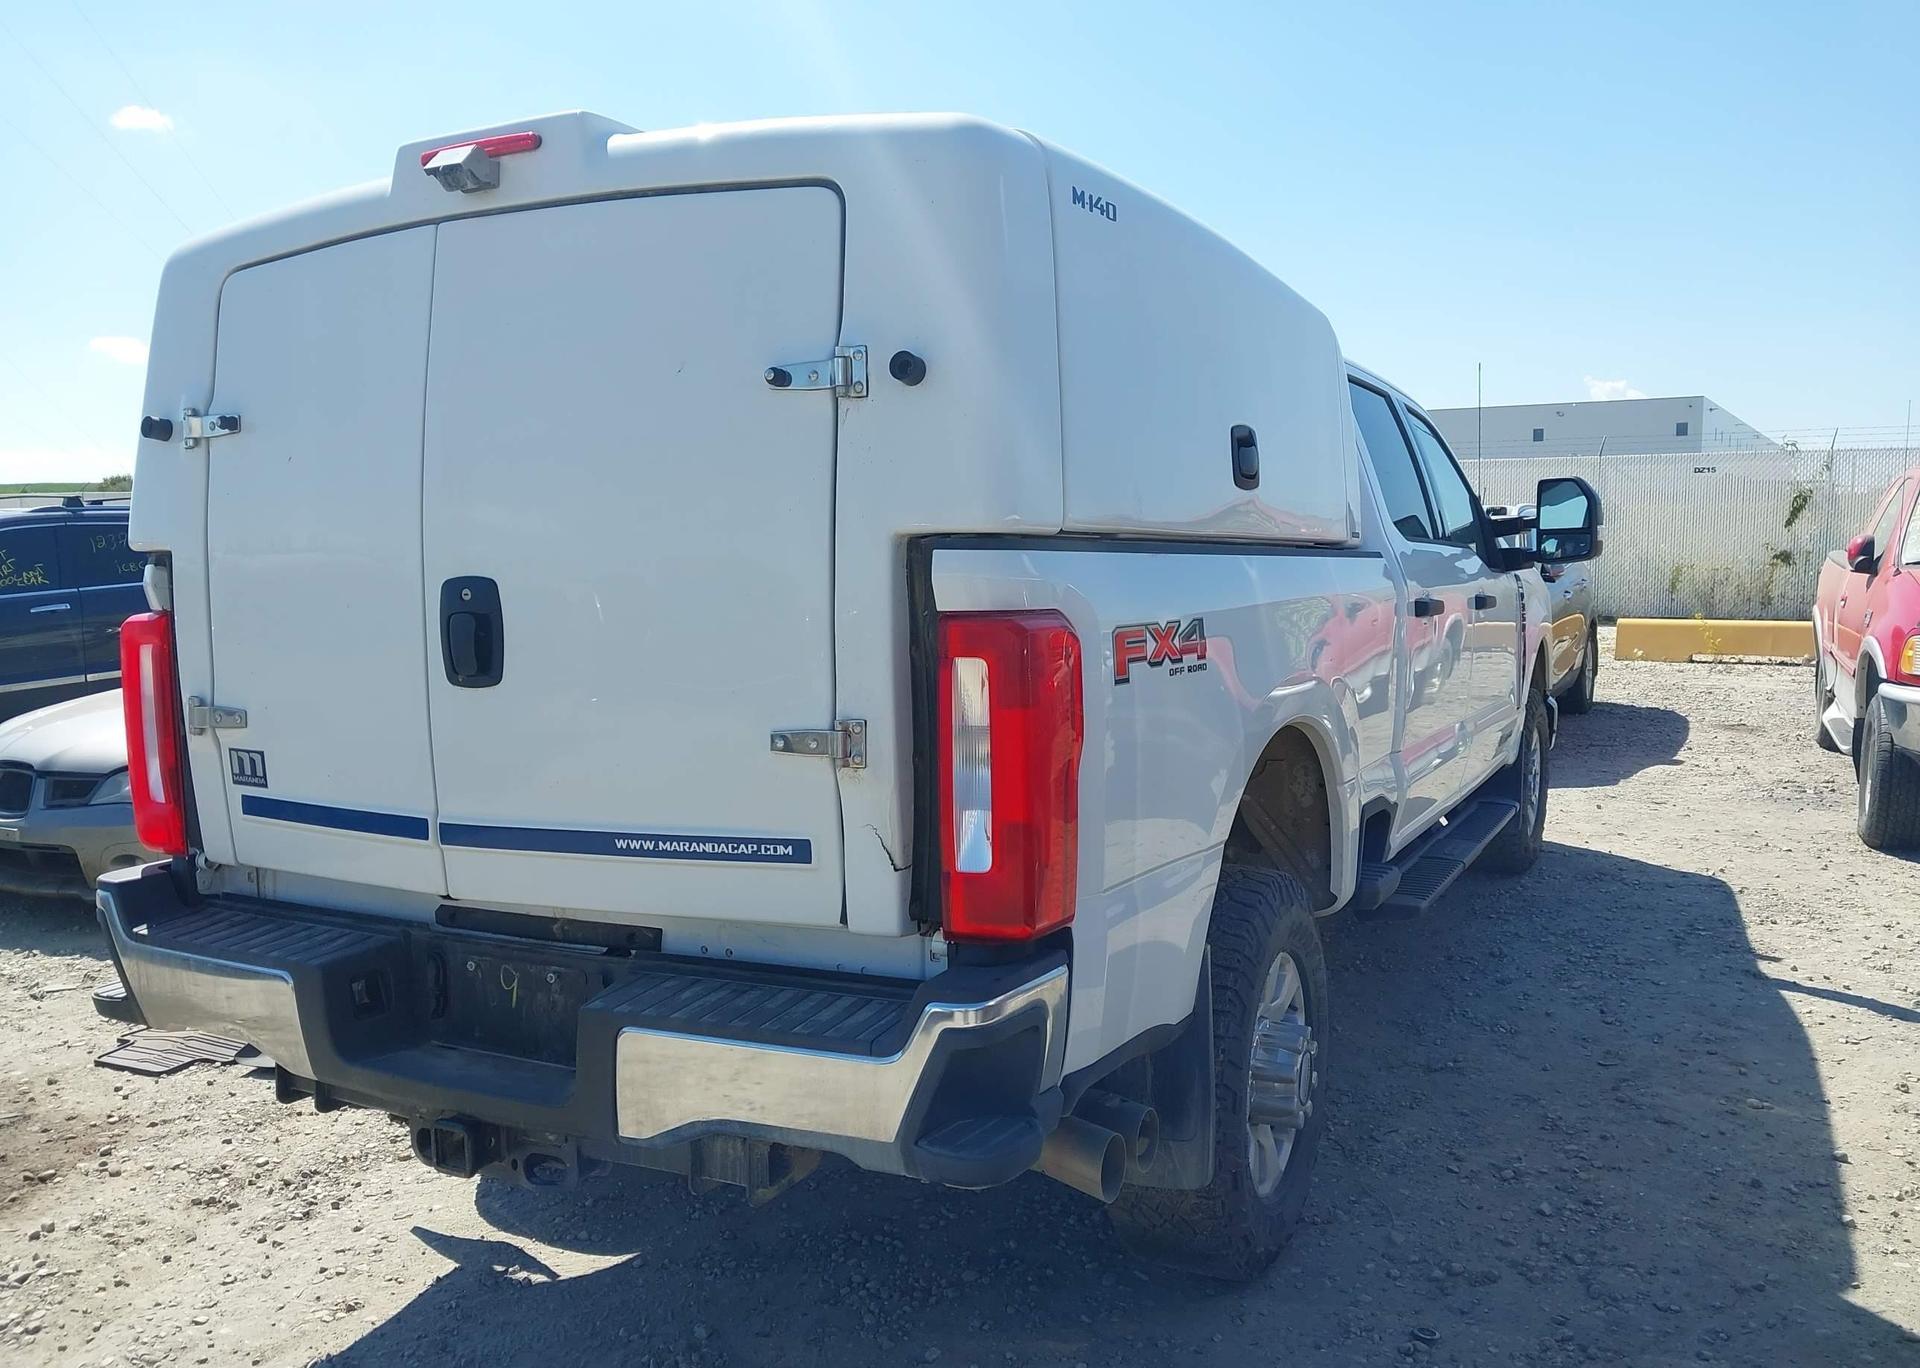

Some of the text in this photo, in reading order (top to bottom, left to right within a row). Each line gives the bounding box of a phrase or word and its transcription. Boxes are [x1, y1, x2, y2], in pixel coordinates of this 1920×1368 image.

[1694, 466, 1717, 474] DZ15
[1112, 616, 1207, 686] FX4
[1169, 663, 1207, 677] OFF ROAD
[615, 838, 793, 856] WWW.MARANDACAP.COM
[500, 964, 519, 1008] 9
